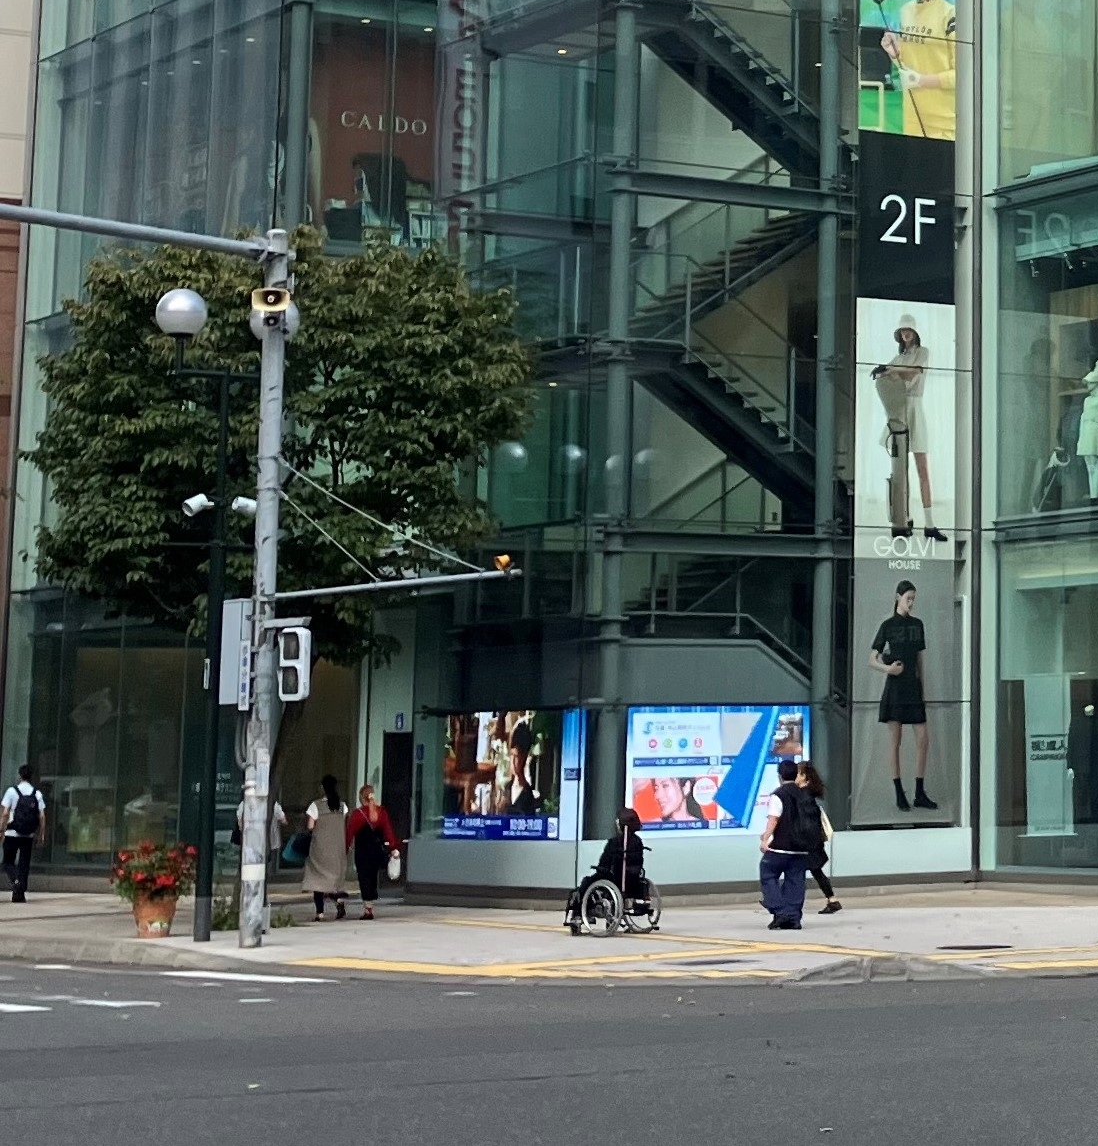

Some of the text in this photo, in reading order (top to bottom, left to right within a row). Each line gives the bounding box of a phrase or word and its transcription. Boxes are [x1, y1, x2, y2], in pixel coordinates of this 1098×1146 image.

[340, 110, 428, 136] CALDO
[880, 194, 936, 245] 2F
[873, 535, 936, 557] GOLVI
[888, 559, 921, 570] HOUSE
